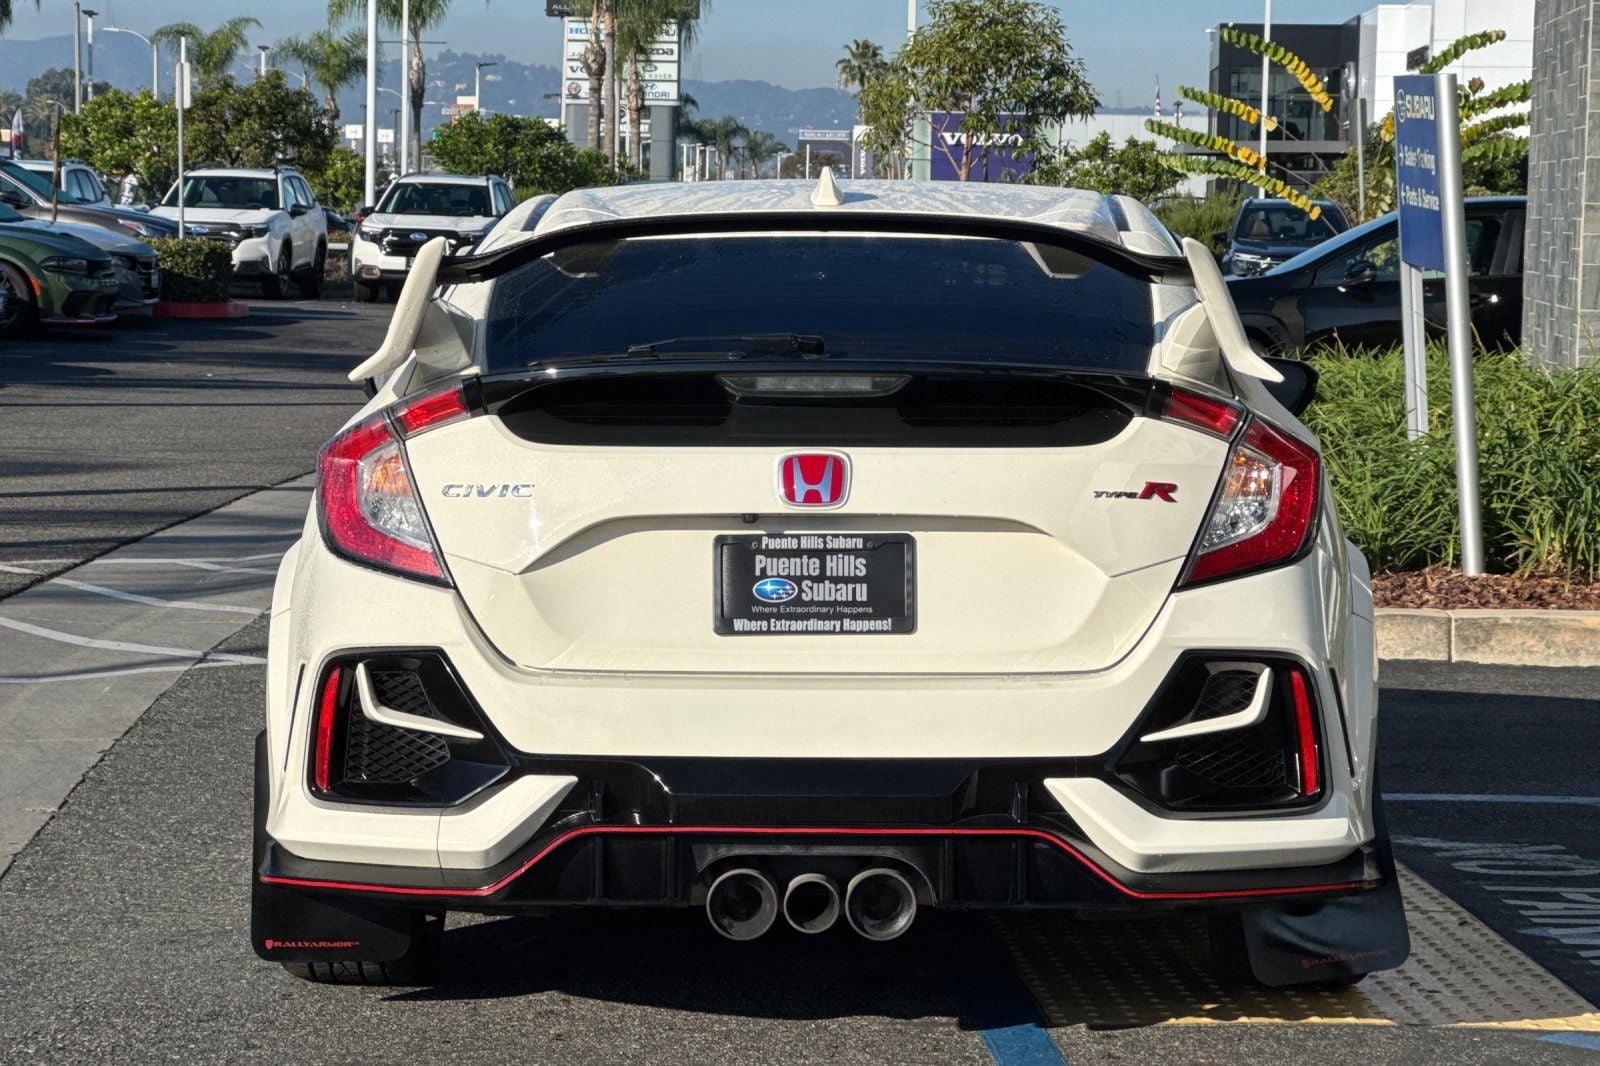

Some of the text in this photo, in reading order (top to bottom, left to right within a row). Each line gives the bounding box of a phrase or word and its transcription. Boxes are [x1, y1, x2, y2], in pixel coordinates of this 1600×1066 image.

[1405, 94, 1435, 120] SUBARU
[1405, 185, 1418, 206] Parts
[1422, 188, 1440, 212] Service
[441, 484, 535, 497] CIVIC
[761, 535, 864, 549] Puente Hills Subaru
[755, 554, 867, 577] Puente Hills
[801, 580, 868, 602] Subaru
[751, 605, 873, 615] Where Extraordinary Happens
[733, 618, 892, 632] Where Extraordinary Happens!
